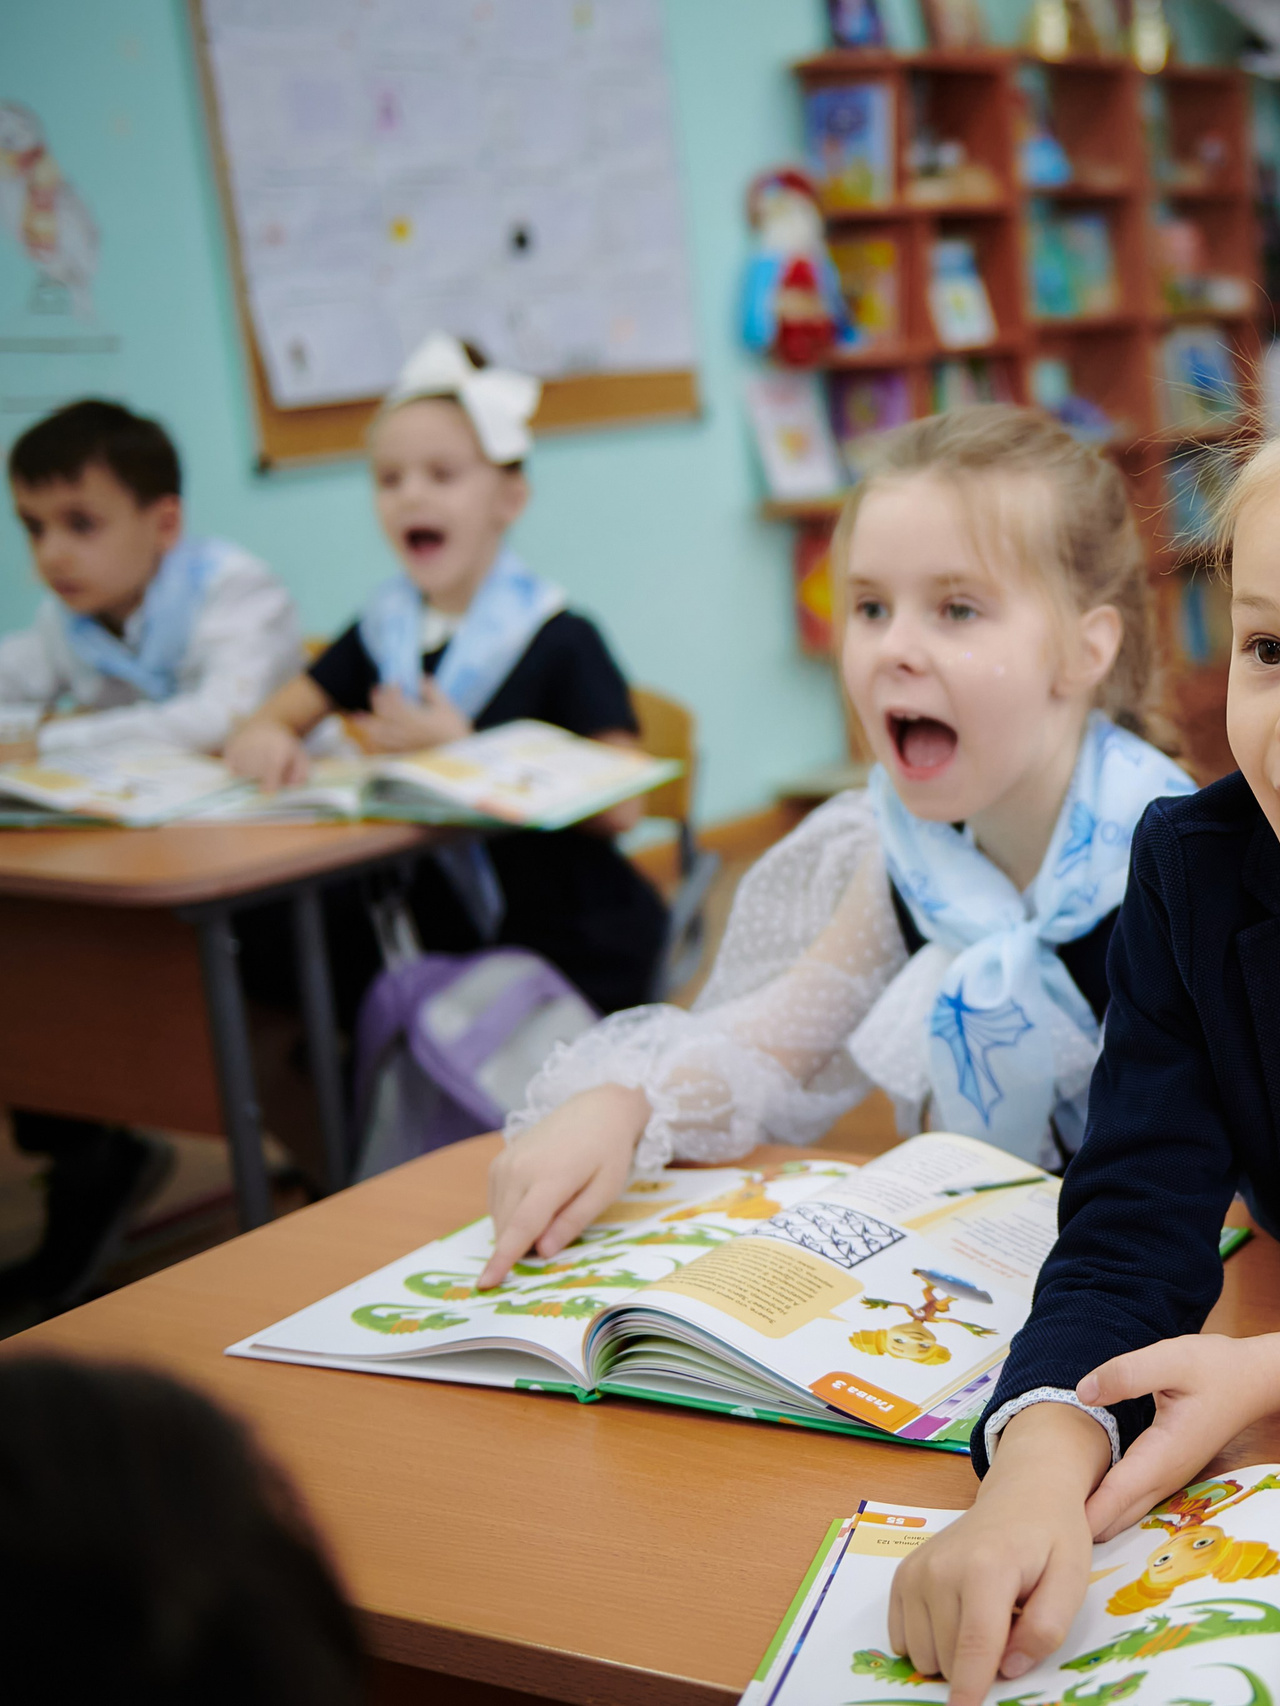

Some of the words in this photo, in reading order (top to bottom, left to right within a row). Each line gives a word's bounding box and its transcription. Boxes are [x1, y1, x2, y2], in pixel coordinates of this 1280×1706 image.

[831, 1379, 847, 1390] 3
[847, 1385, 895, 1413] Глава
[885, 1516, 905, 1525] 55
